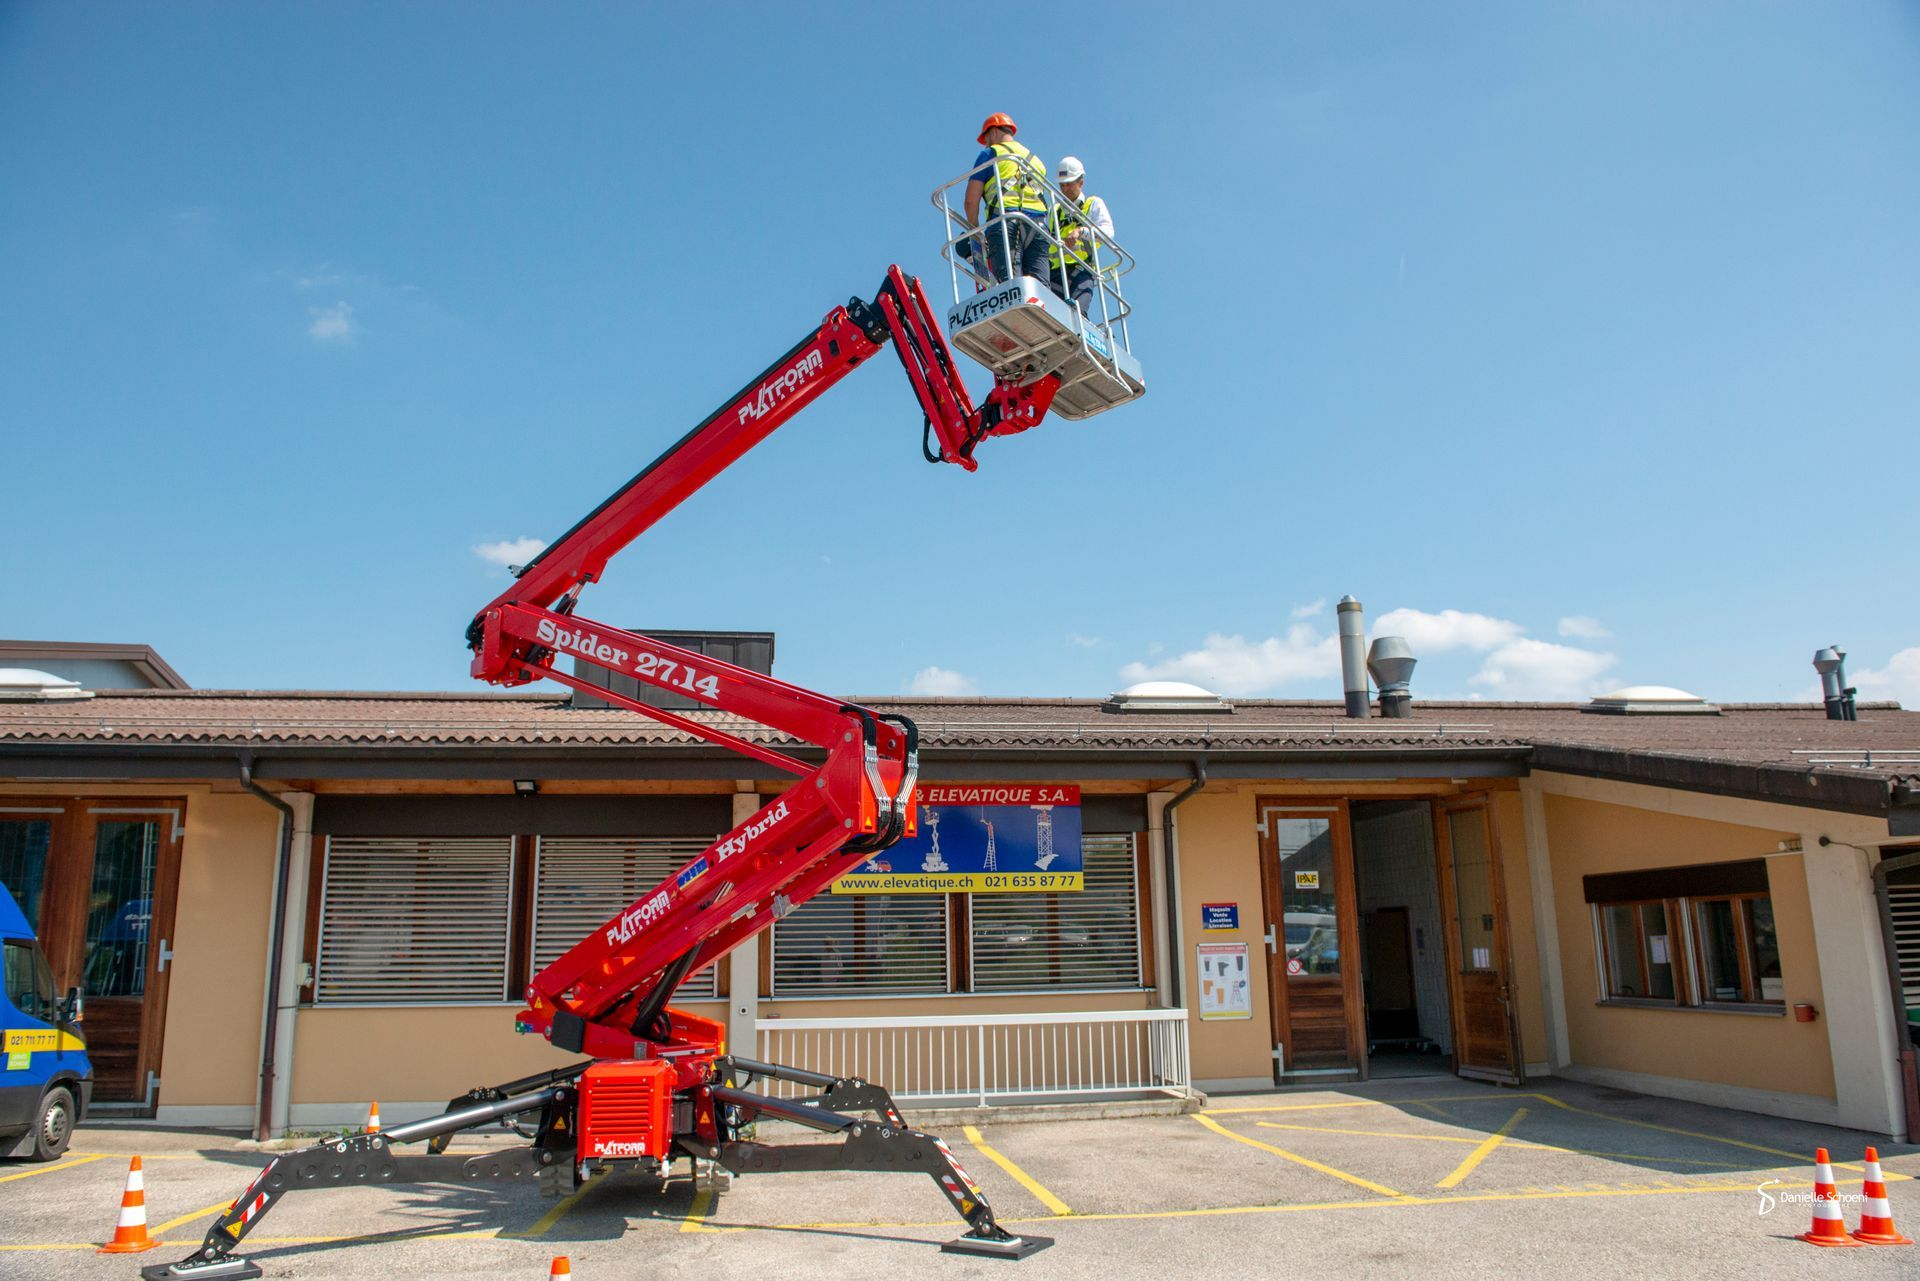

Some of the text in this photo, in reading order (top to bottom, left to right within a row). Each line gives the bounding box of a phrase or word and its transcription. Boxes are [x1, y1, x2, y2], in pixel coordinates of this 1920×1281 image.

[949, 286, 1022, 329] PLATFORM
[738, 349, 823, 425] PLATFORM
[770, 362, 823, 408] BASKET
[536, 618, 721, 700] Spider 27.14
[929, 788, 1031, 803] ELEVATIQUE
[1037, 788, 1069, 802] S.A.
[715, 800, 791, 863] Hybrid
[840, 875, 1075, 890] www.elevatique.ch 021 635 87 77
[606, 890, 671, 946] PLATFORM
[11, 1035, 23, 1045] 021
[594, 1140, 645, 1154] PLATFORM
